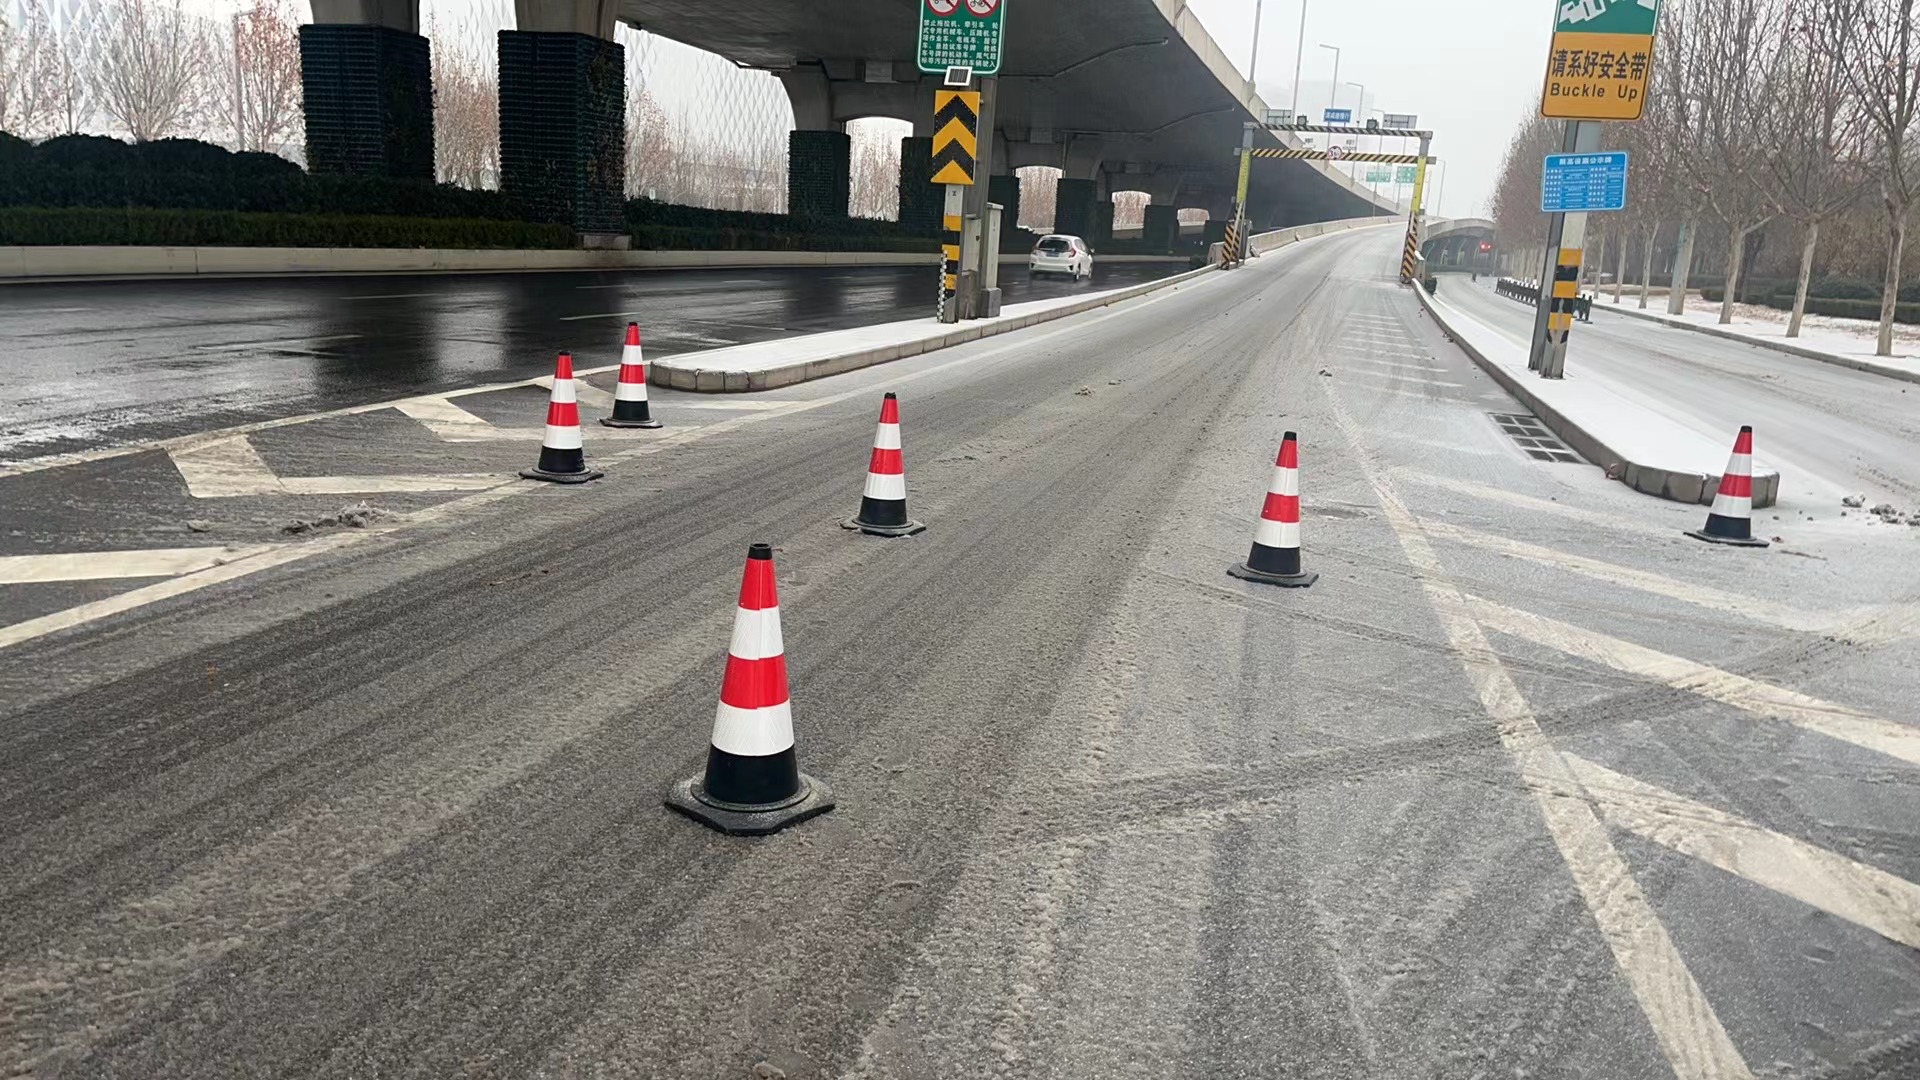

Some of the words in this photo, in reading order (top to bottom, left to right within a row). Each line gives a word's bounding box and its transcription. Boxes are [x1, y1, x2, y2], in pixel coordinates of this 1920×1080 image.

[924, 19, 998, 29] 禁止拖拉机、牵引车轮
[1552, 48, 1646, 80] 请系好安全带
[1550, 82, 1605, 98] Buckle
[1617, 84, 1638, 102] Up
